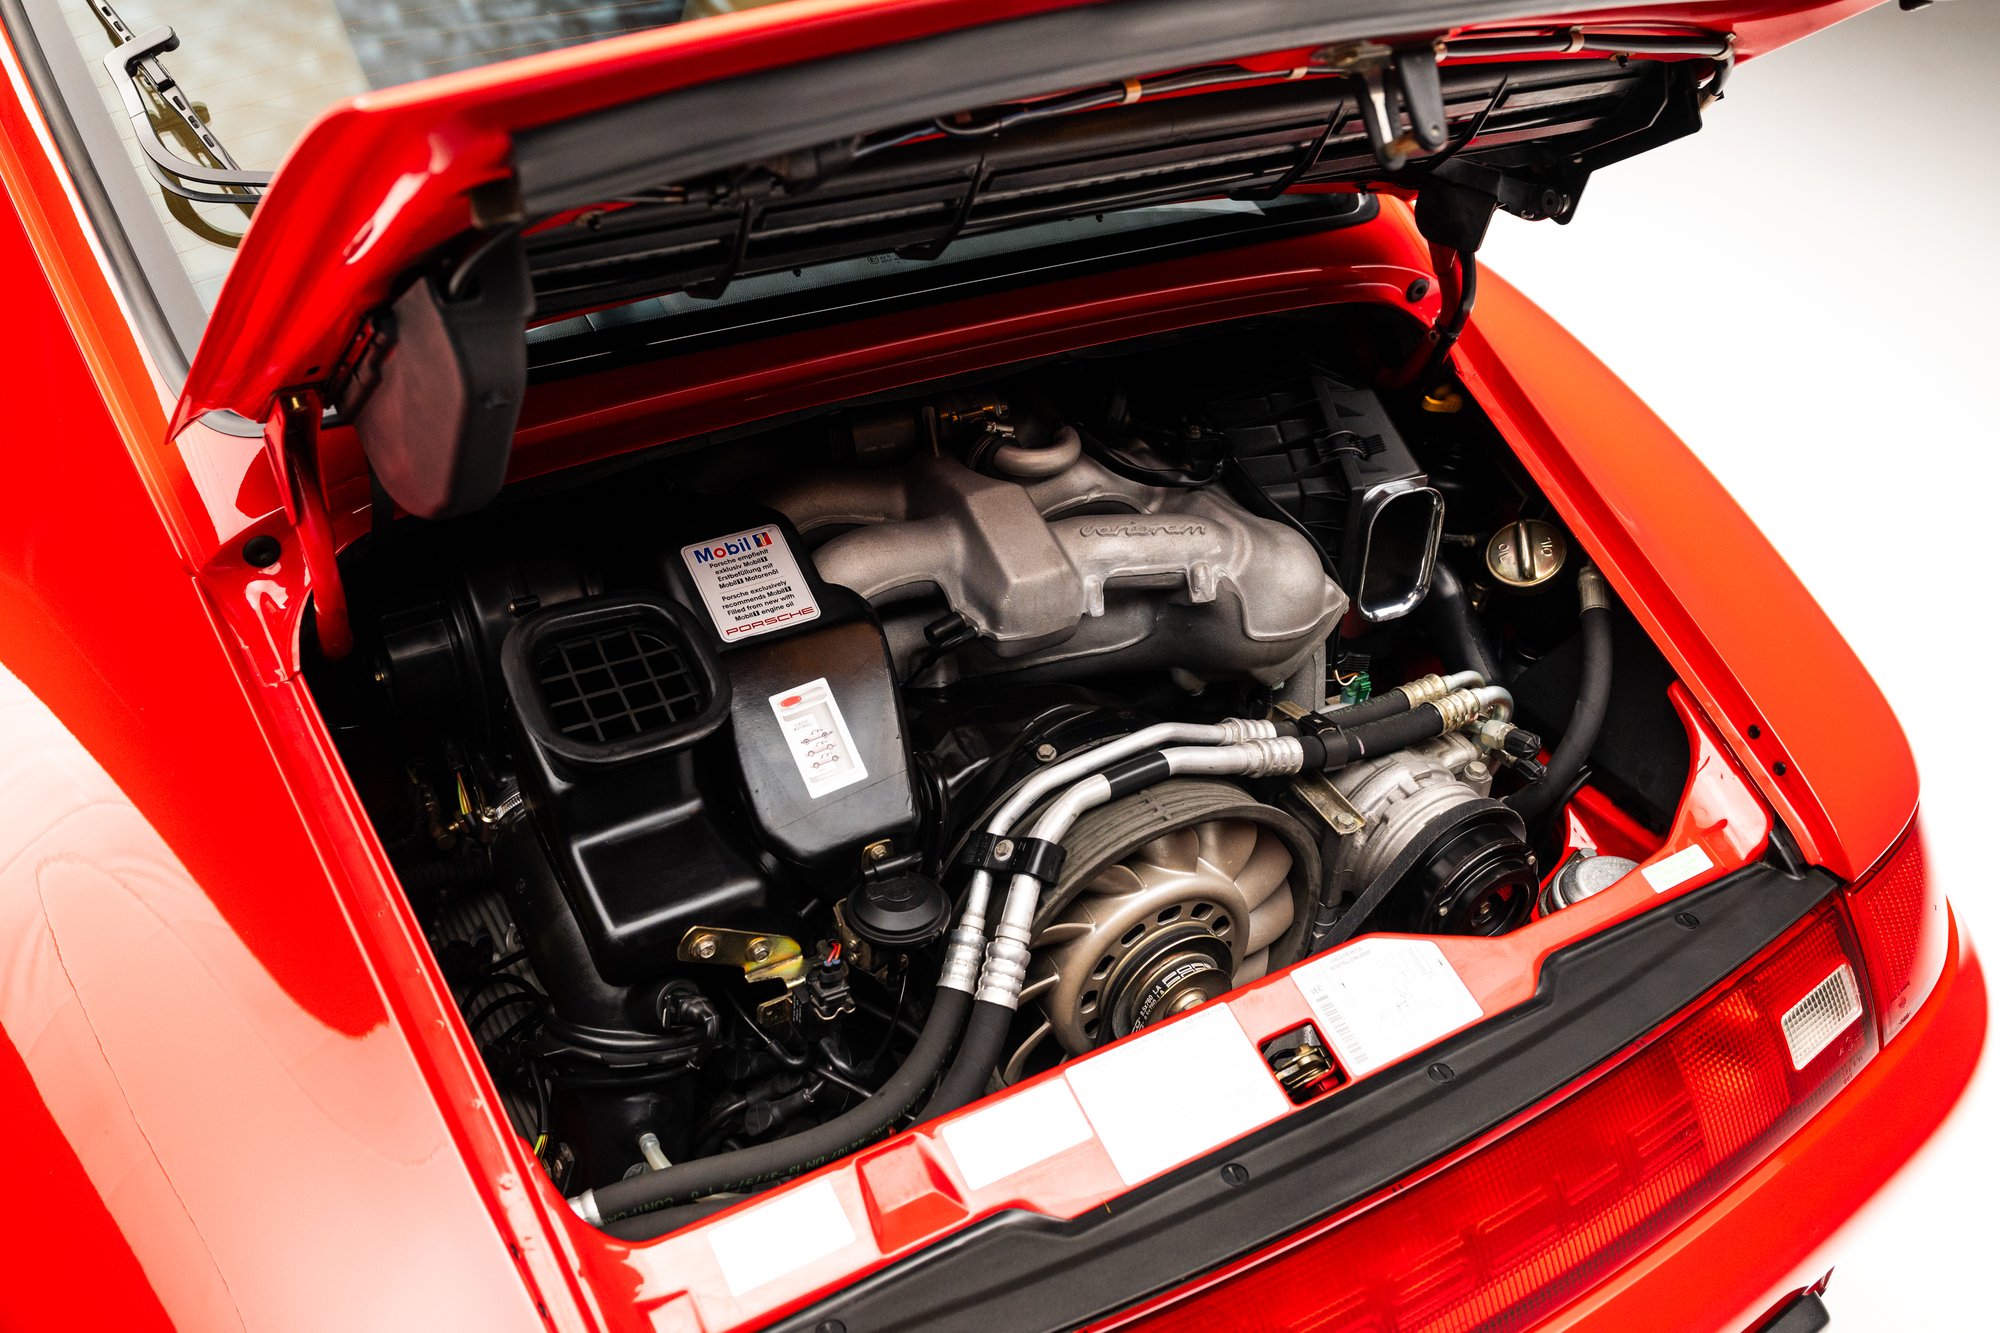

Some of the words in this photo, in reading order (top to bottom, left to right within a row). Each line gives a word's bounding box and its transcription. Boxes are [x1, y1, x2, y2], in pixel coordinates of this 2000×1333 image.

[693, 537, 752, 564] Mobil
[1498, 543, 1510, 564] OIL
[1540, 537, 1553, 557] OIL
[709, 558, 736, 569] Porsche
[737, 549, 769, 562] empfiehlt
[715, 564, 742, 575] exklusiv
[717, 566, 761, 582] Erstbefüllung
[762, 562, 774, 570] mit
[744, 569, 779, 583] Motorenöl
[721, 590, 749, 602] Porsche
[750, 580, 787, 595] exclusively
[721, 594, 767, 610] recommends
[727, 606, 746, 616] Filled
[747, 602, 763, 612] from
[764, 598, 779, 606] new
[780, 593, 795, 602] with
[761, 604, 785, 616] engine
[725, 606, 815, 636] PORSCHE
